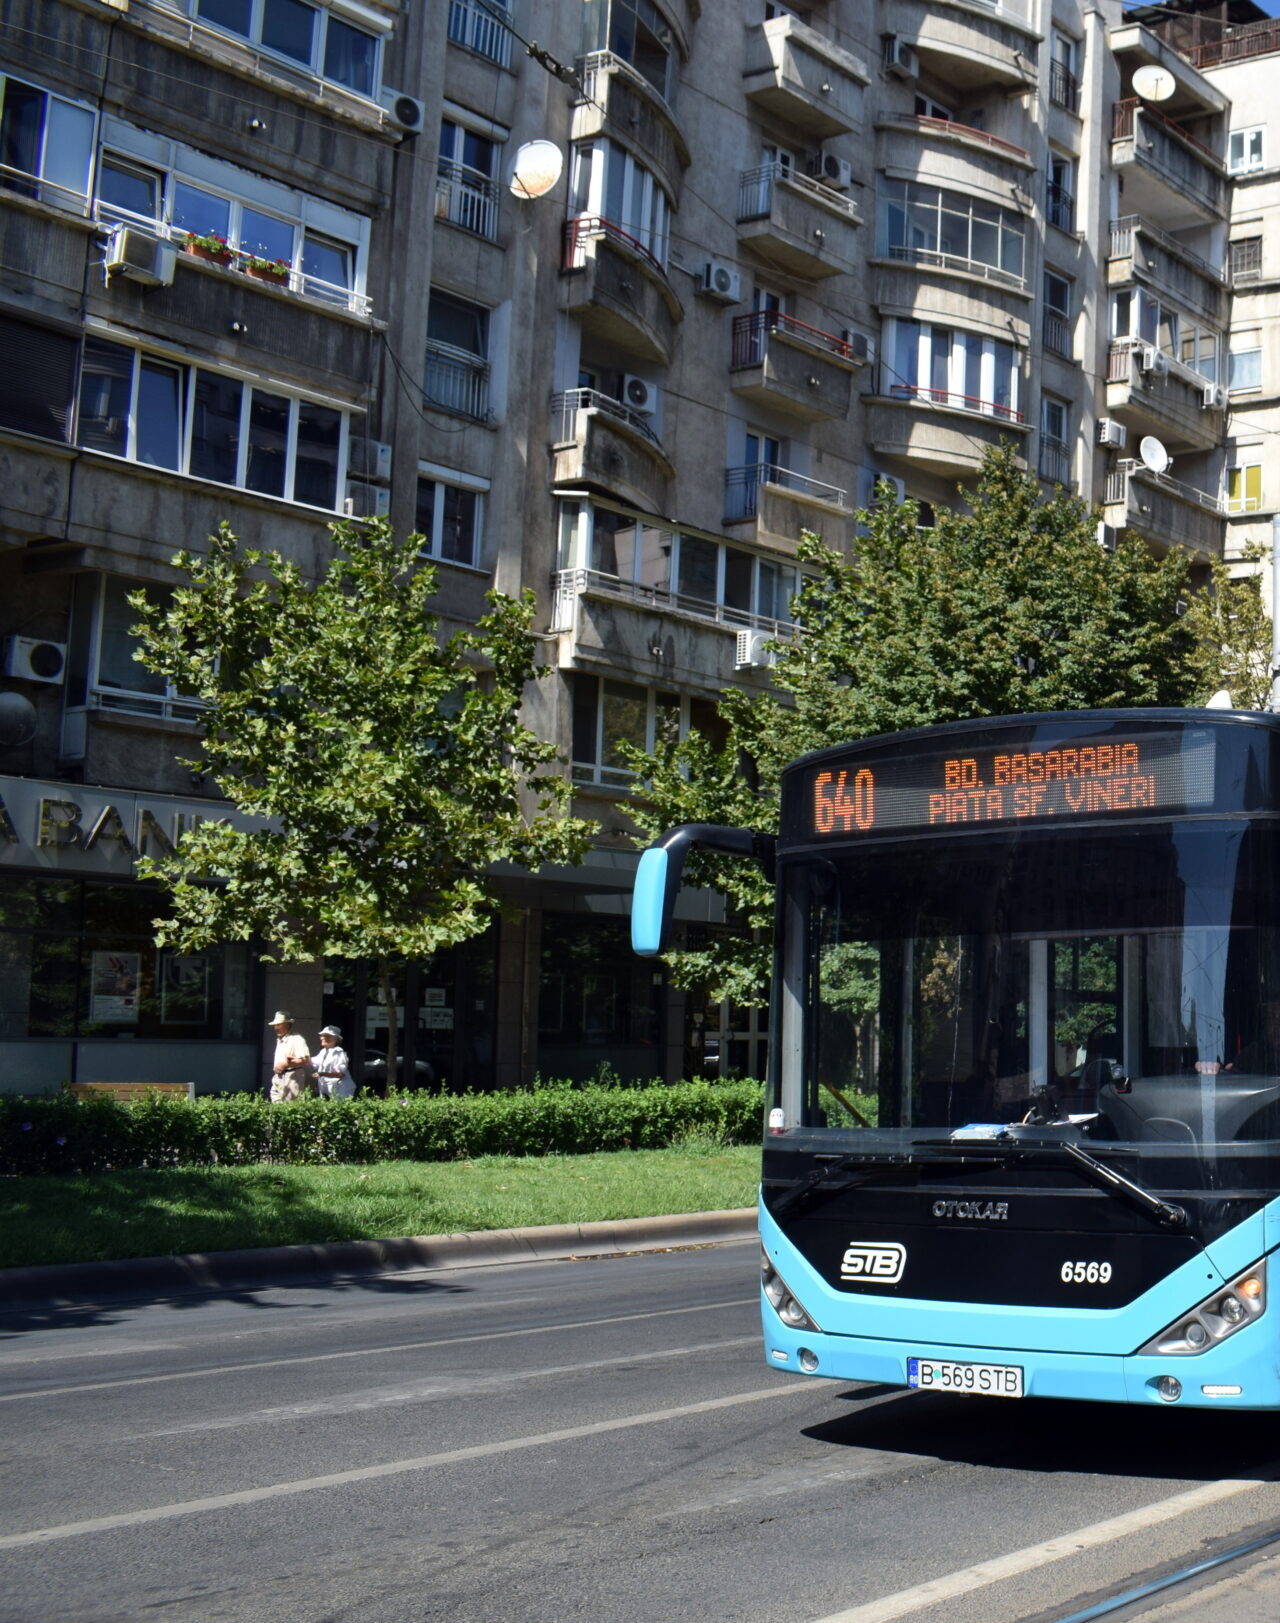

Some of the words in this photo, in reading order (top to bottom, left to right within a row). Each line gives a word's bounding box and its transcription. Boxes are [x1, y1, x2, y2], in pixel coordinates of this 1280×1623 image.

[945, 758, 983, 790] BD.
[994, 743, 1139, 786] BASARABIA
[815, 769, 874, 833] 640
[929, 789, 1002, 824] PIATA
[1014, 785, 1055, 817] SF.
[1066, 775, 1156, 813] VINERI
[932, 1201, 1008, 1219] OTOKAR
[840, 1247, 901, 1276] STB
[1061, 1261, 1112, 1284] 6569
